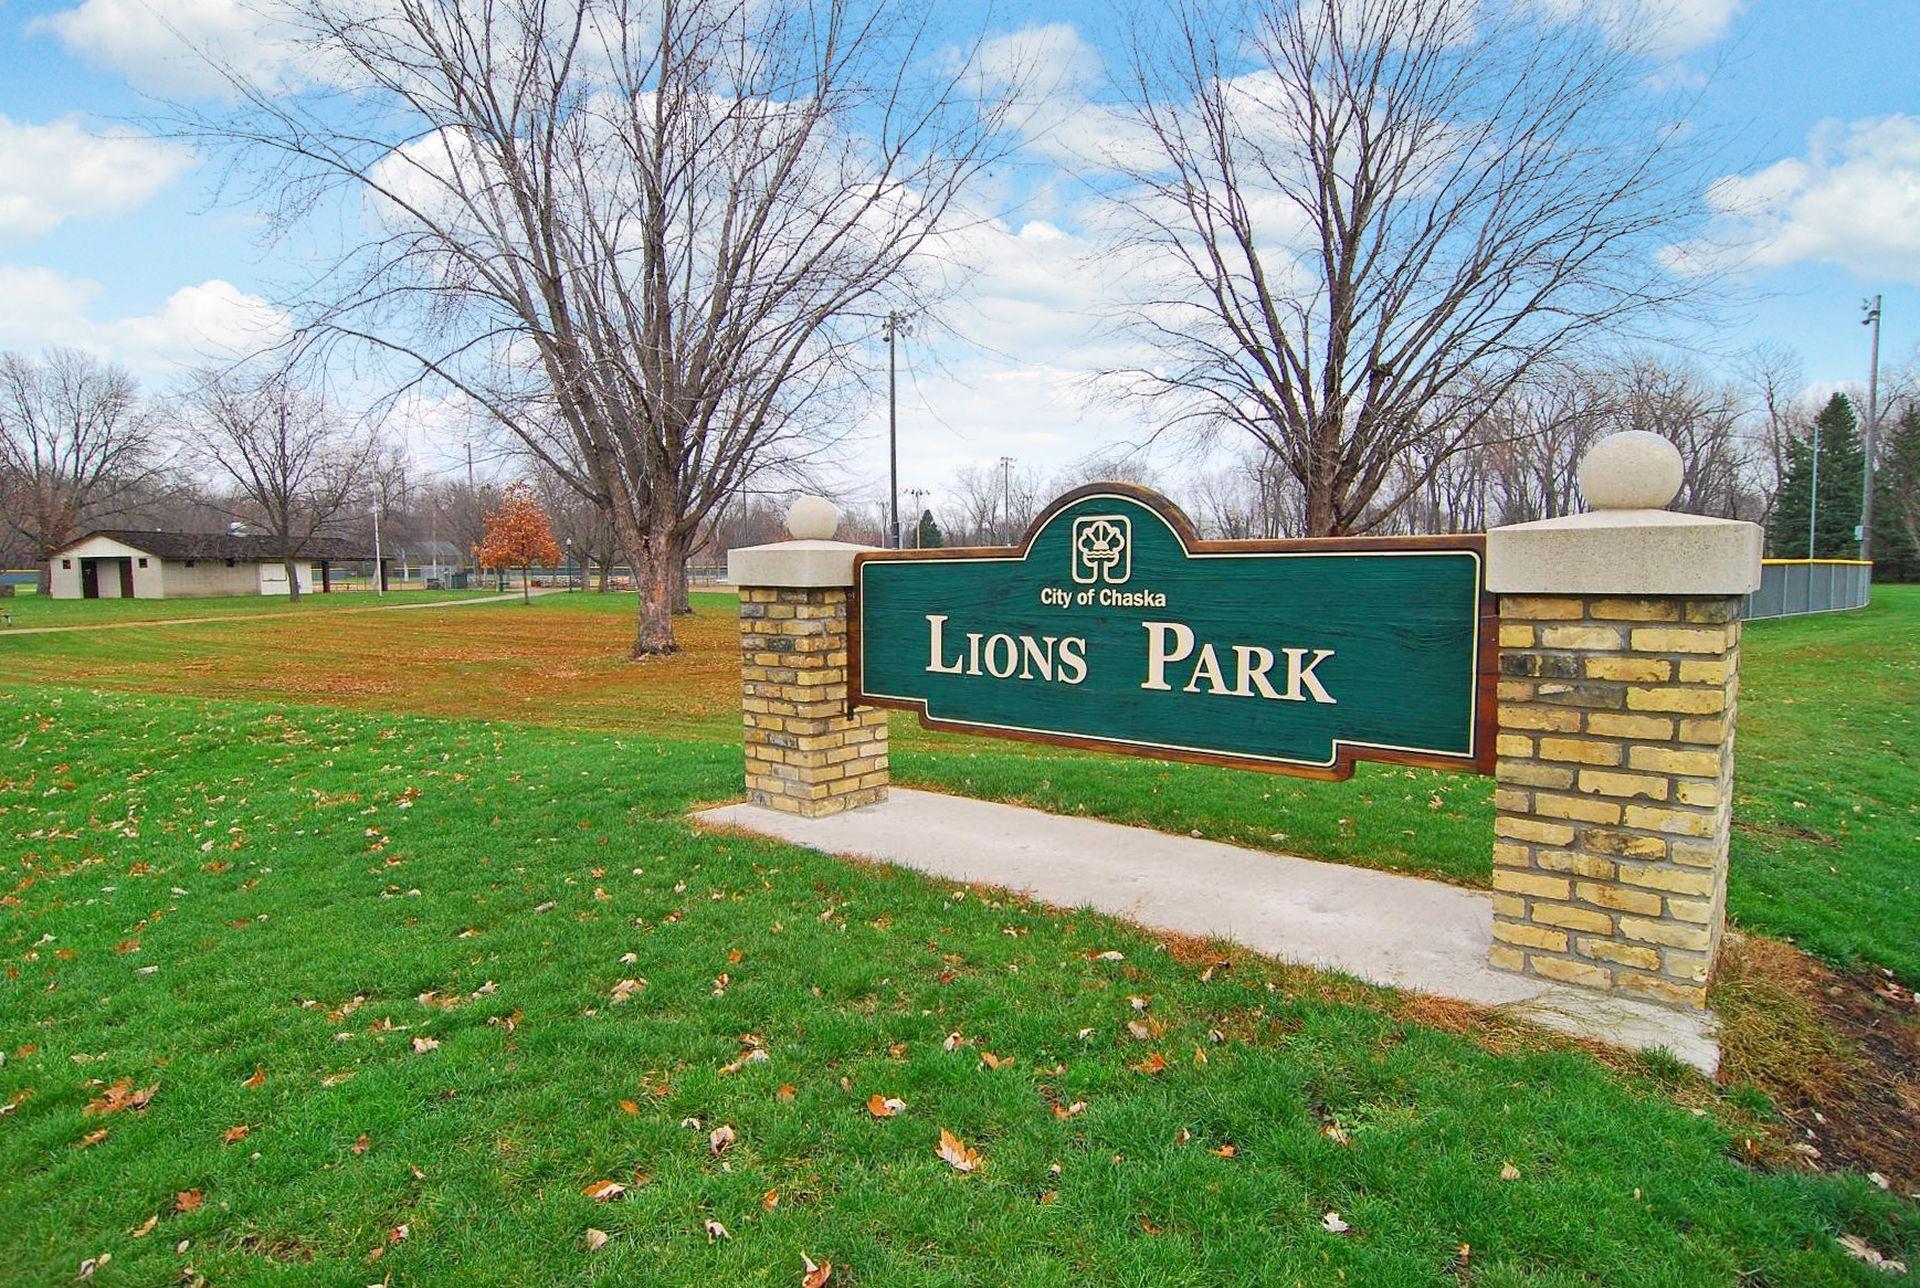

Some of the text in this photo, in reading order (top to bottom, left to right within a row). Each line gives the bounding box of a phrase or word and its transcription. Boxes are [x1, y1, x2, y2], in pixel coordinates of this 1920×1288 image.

[1041, 587, 1167, 609] City of Chaska
[925, 614, 1338, 705] LIONS PARK
